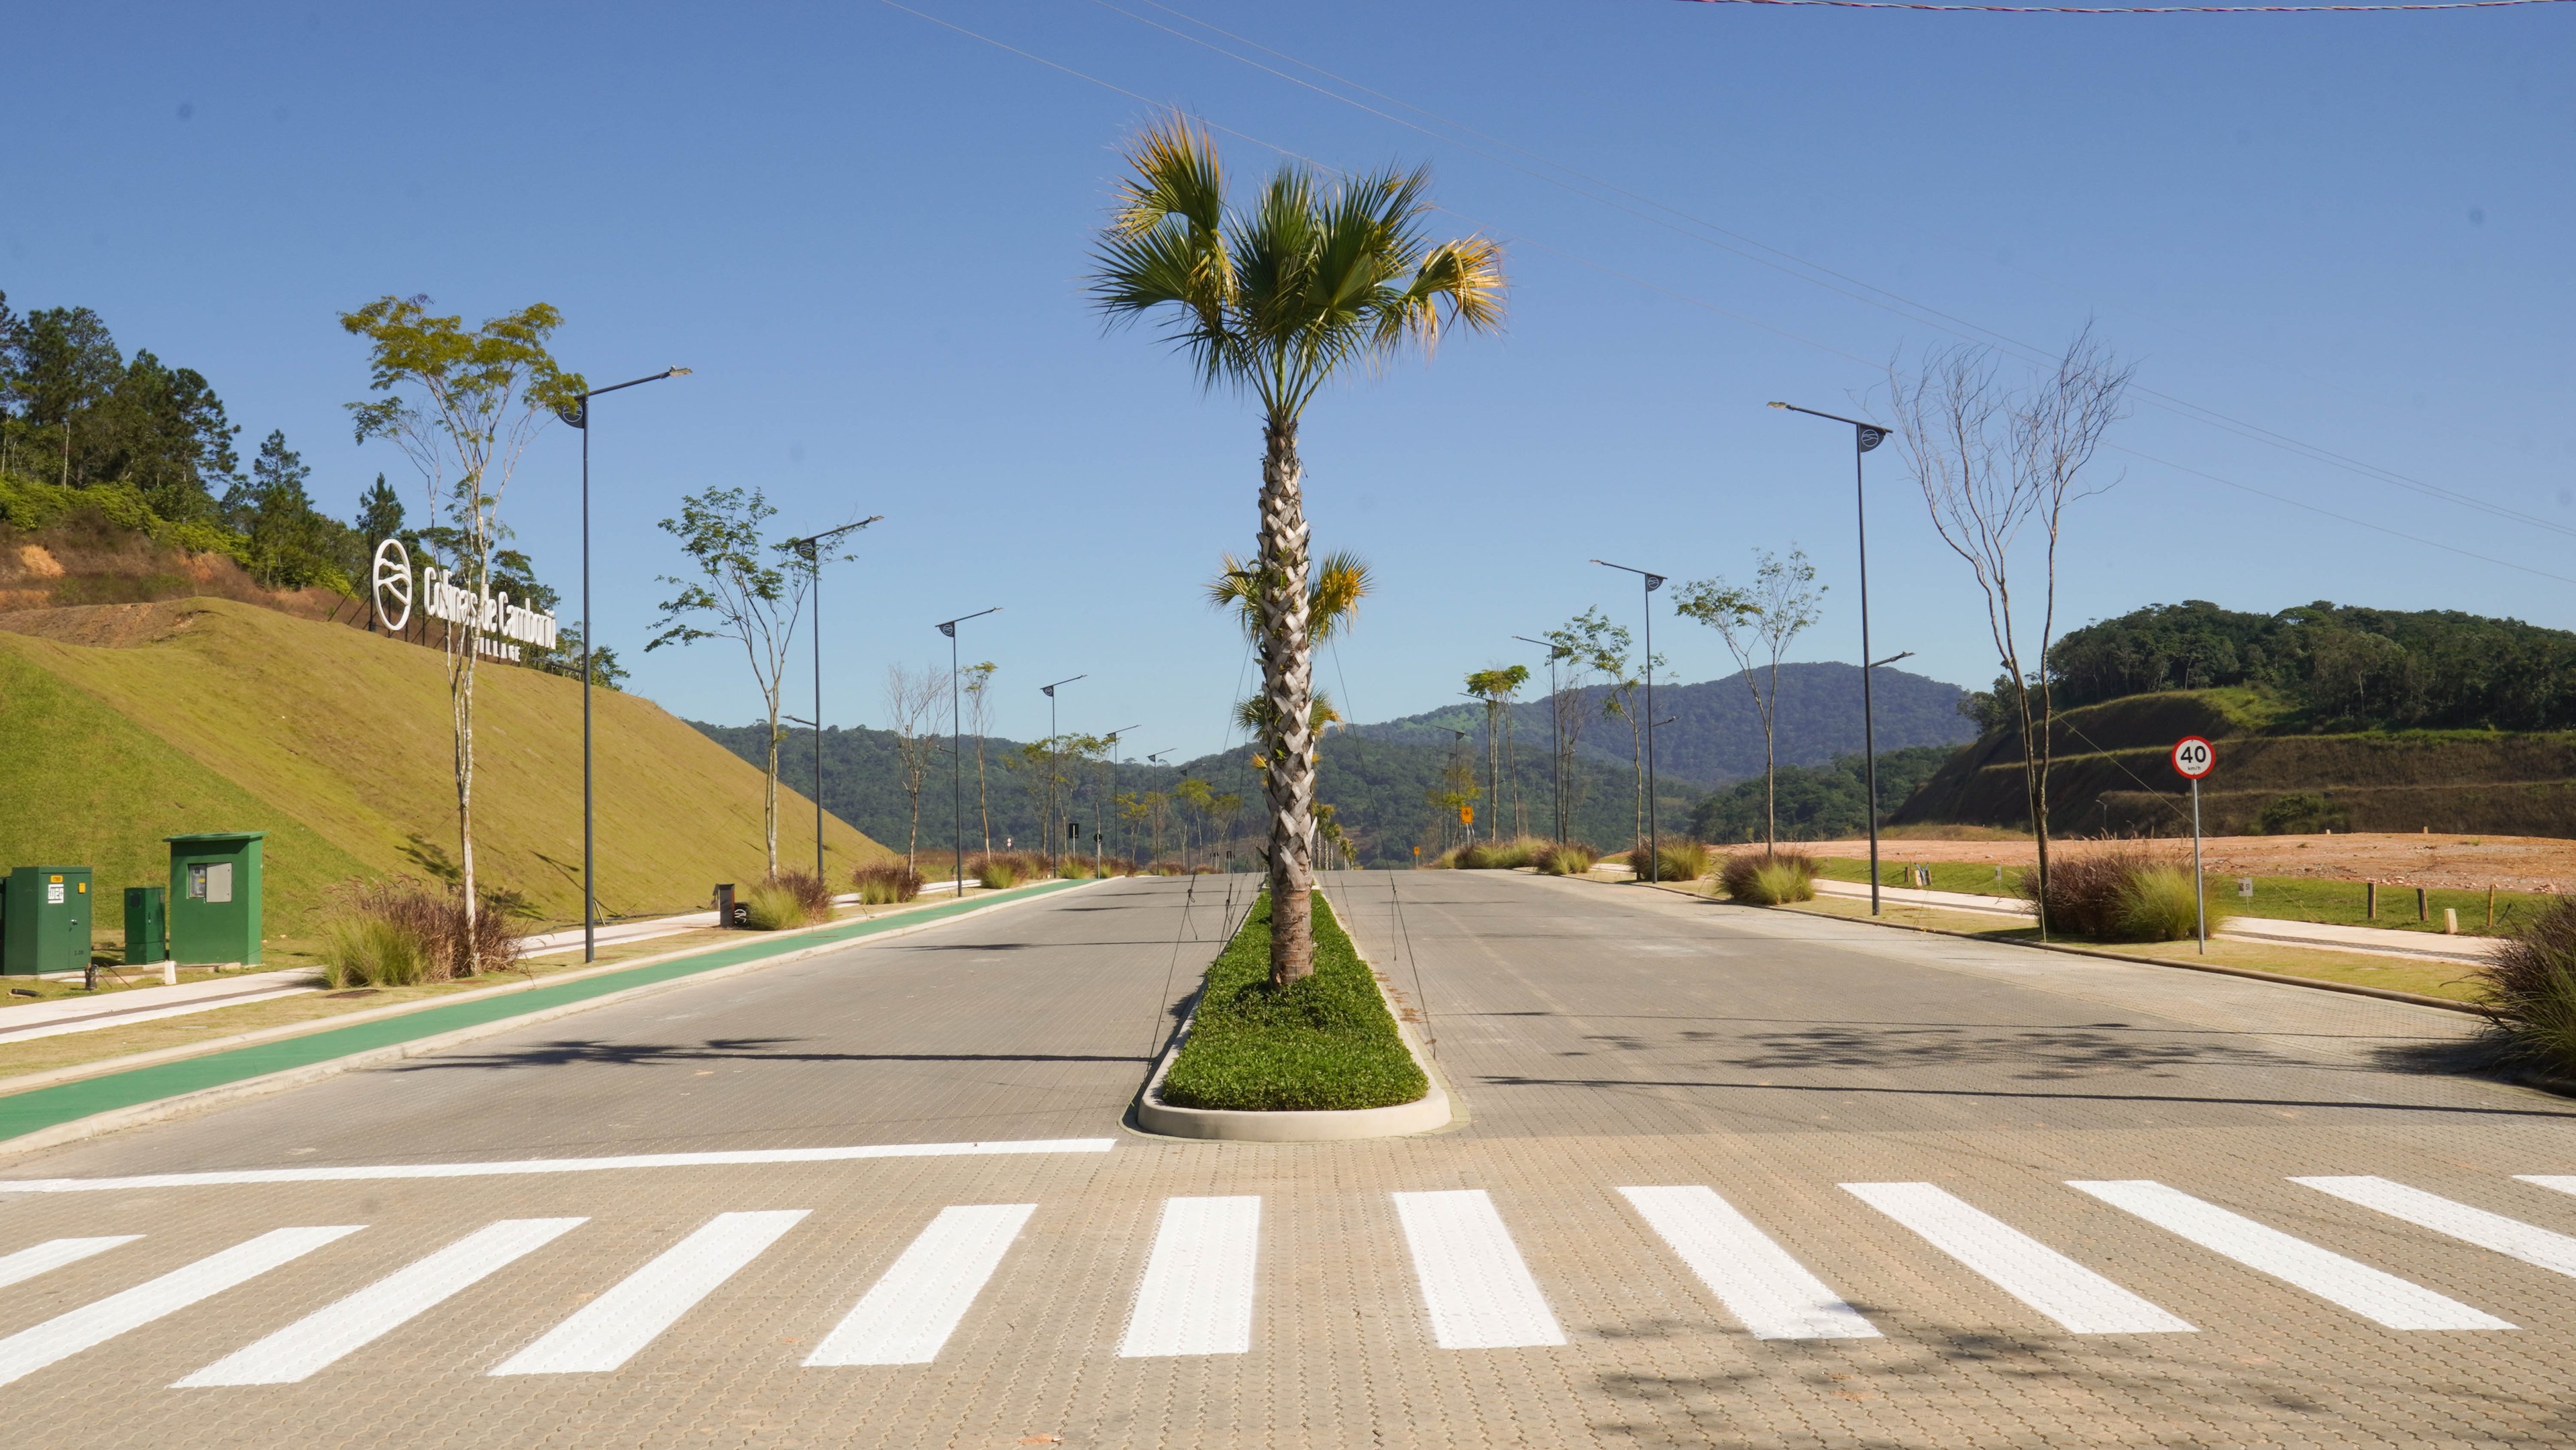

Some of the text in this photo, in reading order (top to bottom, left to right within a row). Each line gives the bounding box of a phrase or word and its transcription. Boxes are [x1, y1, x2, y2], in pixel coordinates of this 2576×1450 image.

[481, 584, 497, 633] de
[479, 637, 521, 662] ILLAGE
[2180, 745, 2206, 763] 40
